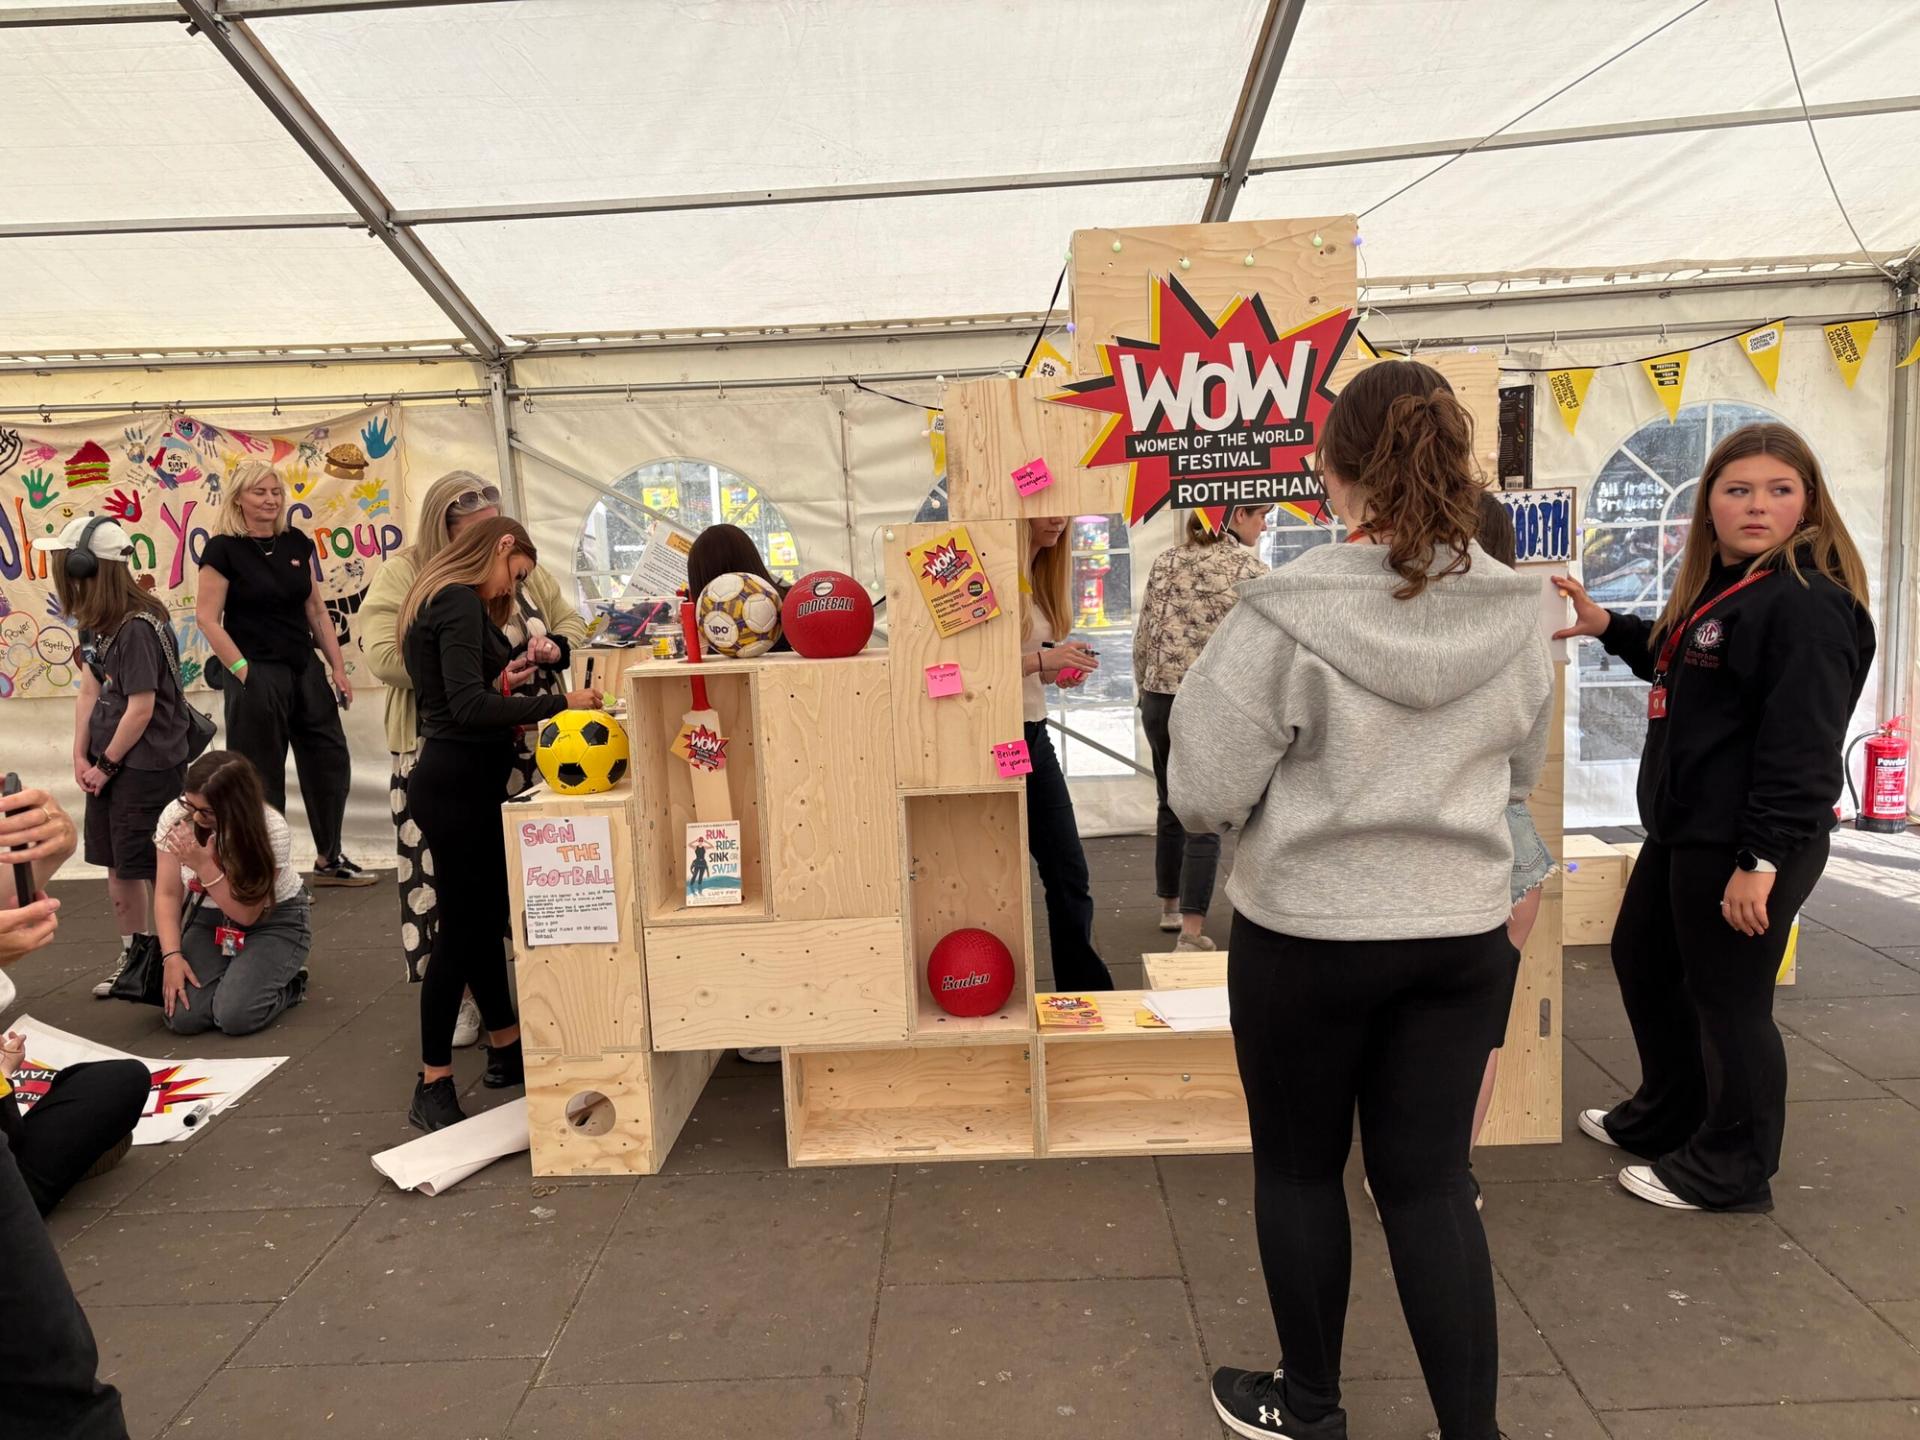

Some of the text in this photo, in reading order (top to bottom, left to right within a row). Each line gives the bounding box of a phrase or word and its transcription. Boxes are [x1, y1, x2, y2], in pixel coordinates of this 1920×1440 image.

[1834, 328, 1854, 363] CAPITAL OF
[1119, 340, 1312, 432] WOW
[1135, 429, 1305, 453] WOMEN OF THE WORLD
[1177, 452, 1261, 471] FESTIVAL
[1177, 475, 1325, 504] ROTHERHAM
[1598, 481, 1619, 498] All
[1502, 499, 1569, 559] OOTH
[925, 546, 956, 577] WOW
[797, 597, 854, 618] DODGEBALL
[40, 639, 72, 653] Together
[691, 732, 721, 752] WOW
[521, 823, 576, 847] SIGN
[556, 842, 601, 863] THE
[708, 852, 739, 863] SINK OR
[526, 864, 614, 887] FOOTBALL
[711, 863, 737, 874] SWIM
[941, 971, 990, 992] Baden
